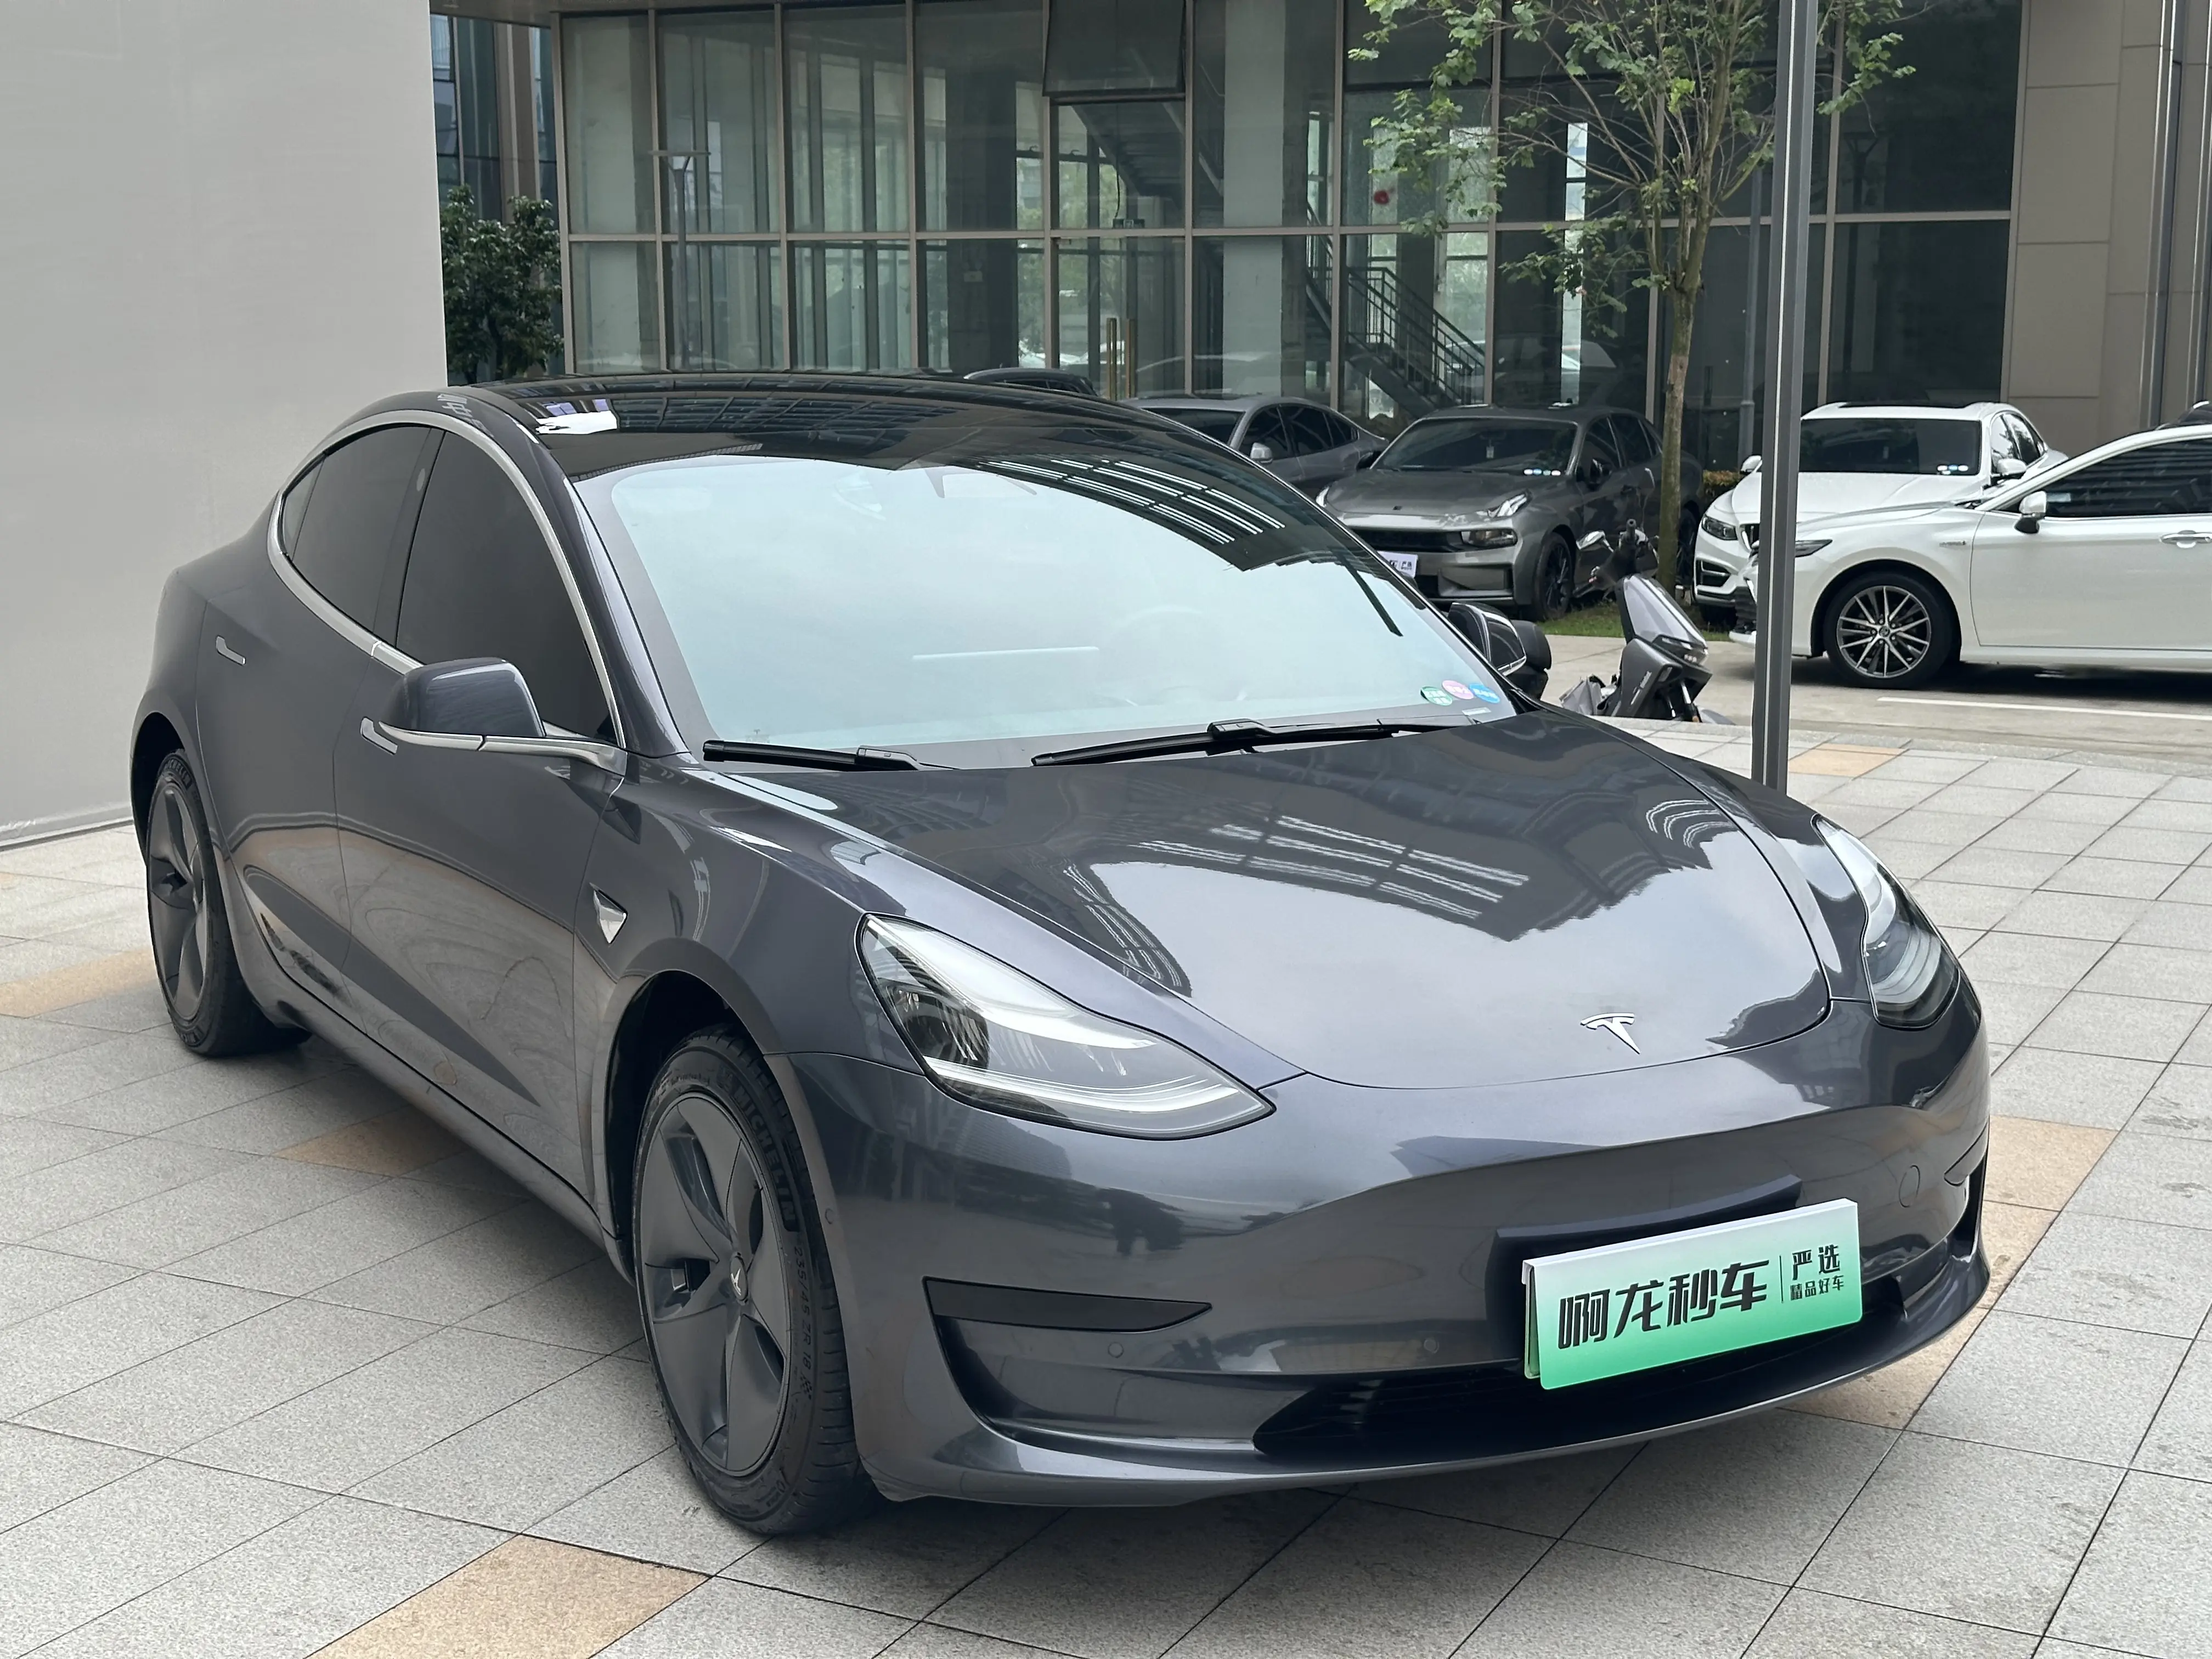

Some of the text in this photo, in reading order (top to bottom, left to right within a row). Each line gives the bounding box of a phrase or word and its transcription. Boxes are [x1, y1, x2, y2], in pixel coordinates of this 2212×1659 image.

[733, 1085, 796, 1221] MICHELIN
[794, 1246, 810, 1316] 235/45
[1792, 1244, 1841, 1281] 严选
[1558, 1259, 1770, 1350] 啊龙秒车
[1790, 1274, 1844, 1301] 精品好车
[803, 1319, 812, 1345] ZR
[803, 1351, 812, 1370] 18
